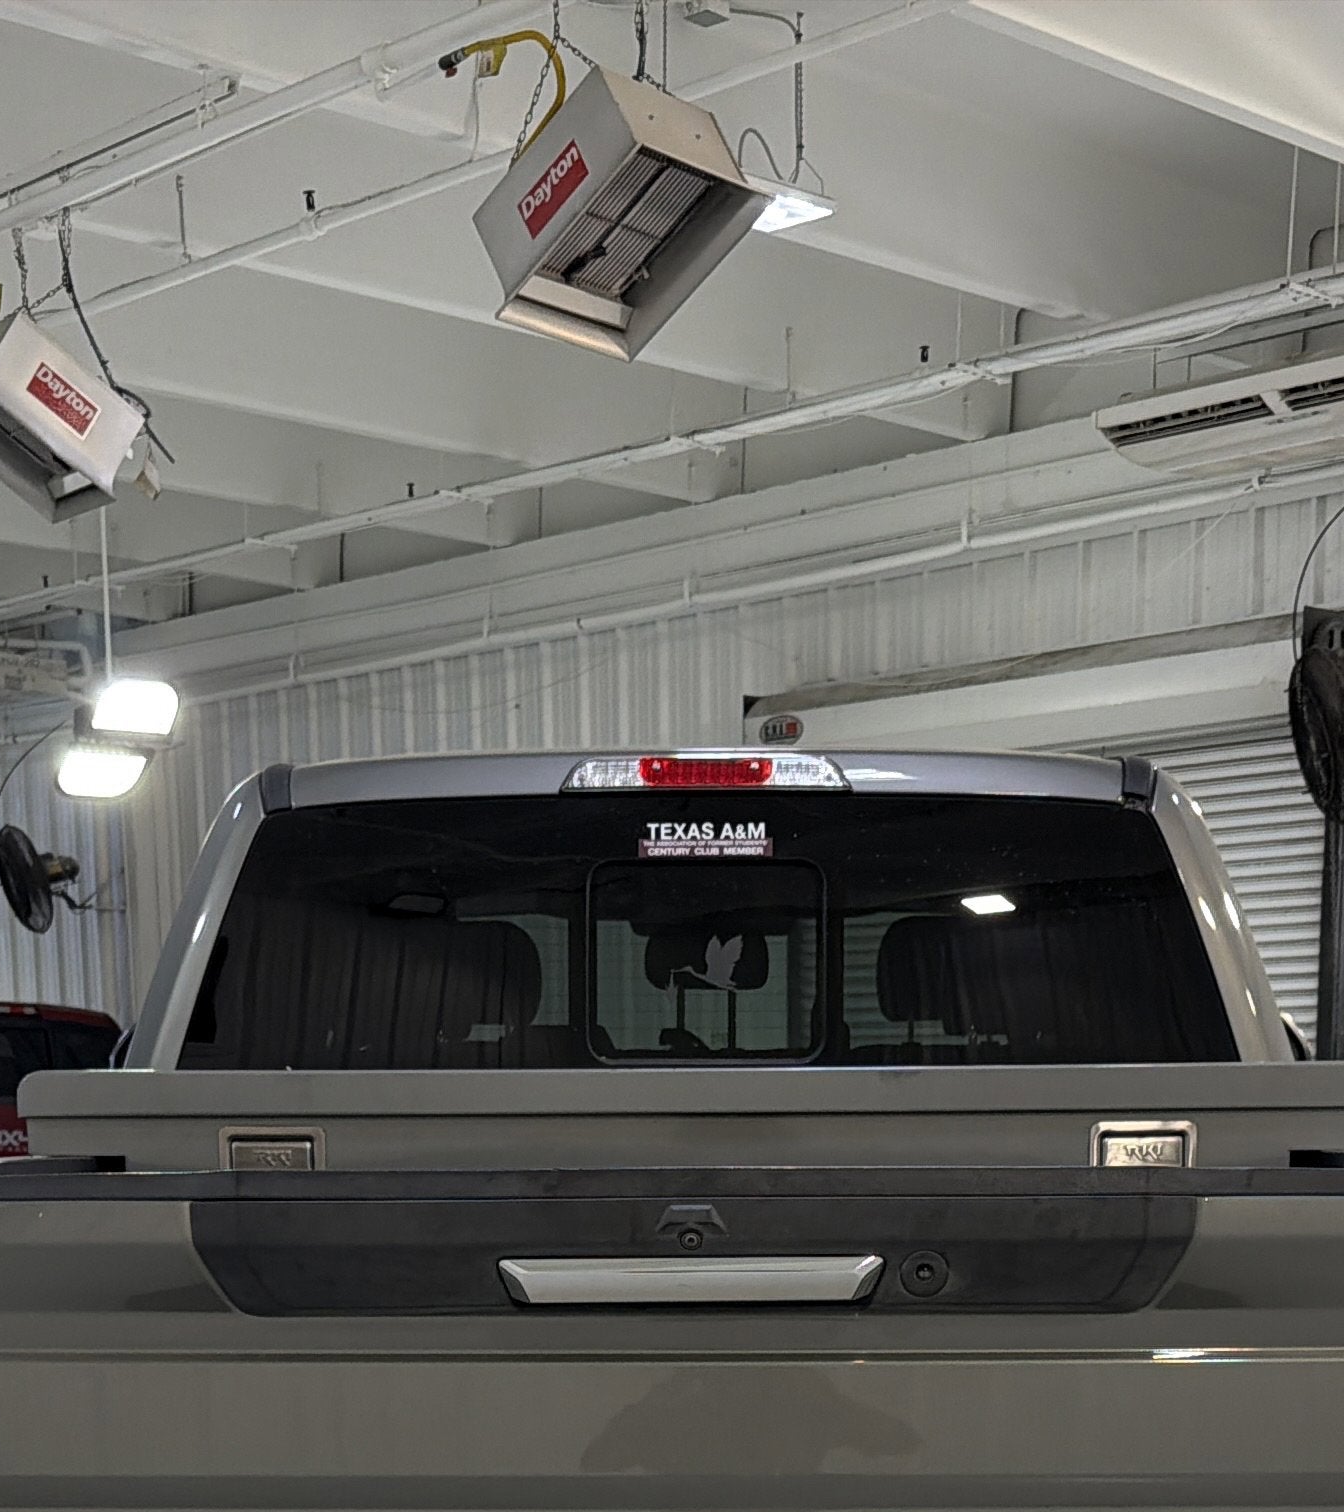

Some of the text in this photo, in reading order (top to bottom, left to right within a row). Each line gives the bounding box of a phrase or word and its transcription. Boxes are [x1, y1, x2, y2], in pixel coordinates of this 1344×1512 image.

[521, 146, 578, 221] Dayton
[36, 366, 94, 420] Dayton
[646, 822, 766, 840] TEXAS A&M
[647, 847, 764, 857] CENTURY CLUB MEMBER
